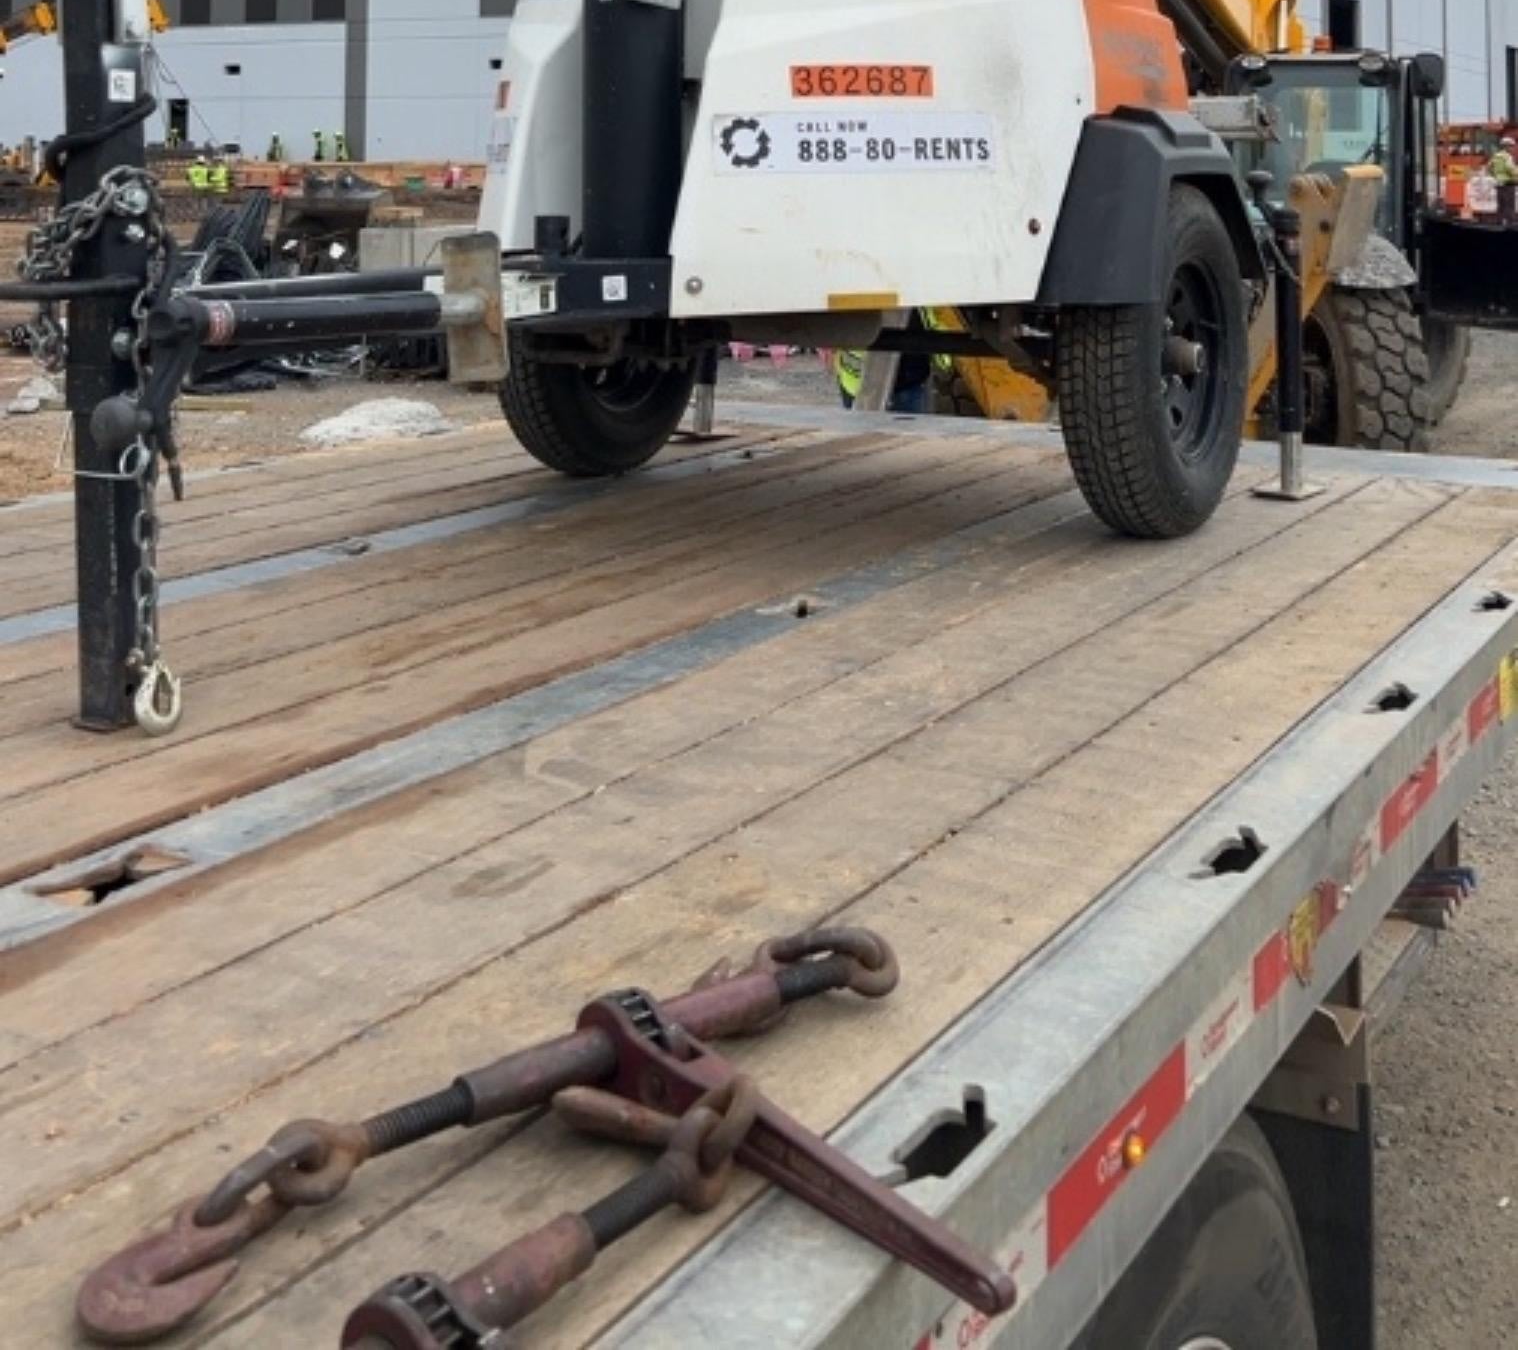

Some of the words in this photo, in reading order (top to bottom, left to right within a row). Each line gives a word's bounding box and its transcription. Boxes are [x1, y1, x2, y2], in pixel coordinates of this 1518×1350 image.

[794, 66, 928, 96] 362687
[797, 122, 831, 133] CALL
[837, 120, 868, 133] NOW
[797, 137, 990, 162] 888-80-RENTS
